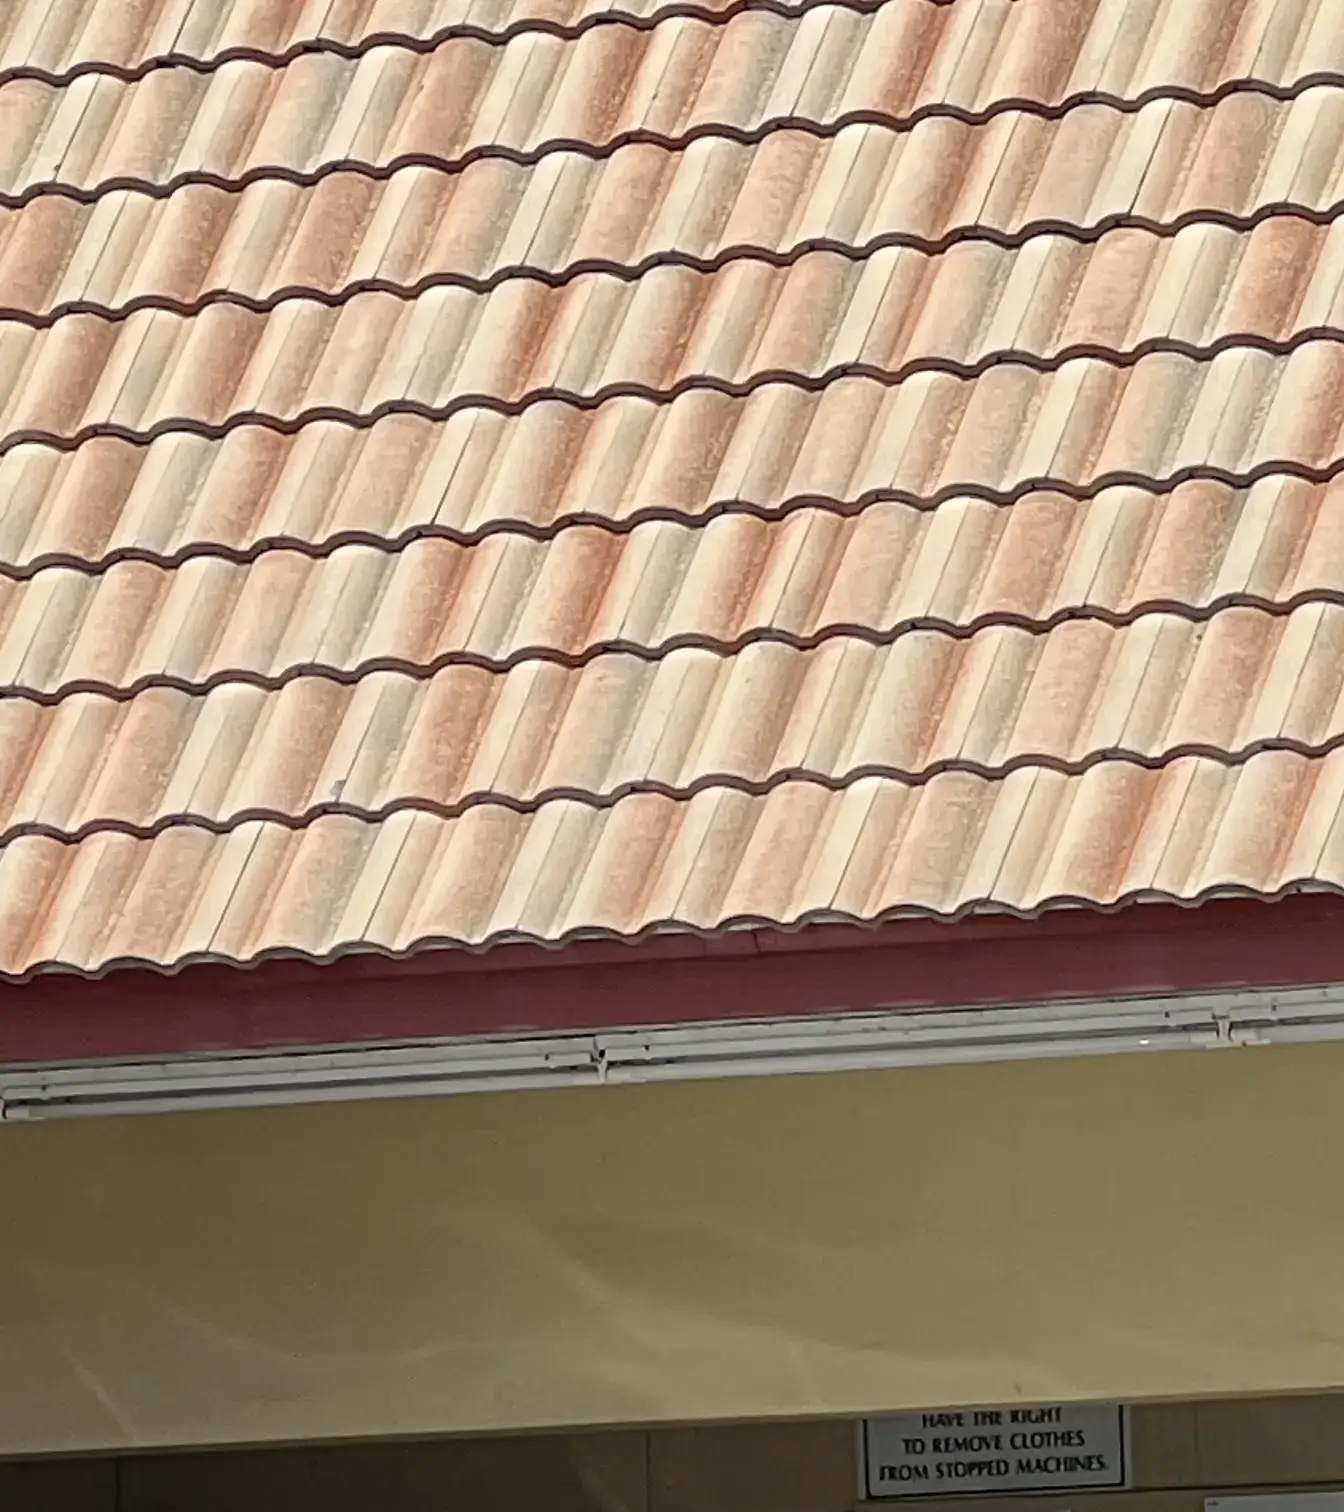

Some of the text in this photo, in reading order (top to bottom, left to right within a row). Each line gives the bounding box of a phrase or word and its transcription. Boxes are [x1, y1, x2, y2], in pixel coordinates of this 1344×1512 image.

[921, 1406, 1062, 1429] HAVE THE RIGHT
[903, 1430, 1085, 1455] TO REMOVE CLOTHES
[879, 1465, 929, 1482] FROM
[935, 1459, 1009, 1480] STOPPED
